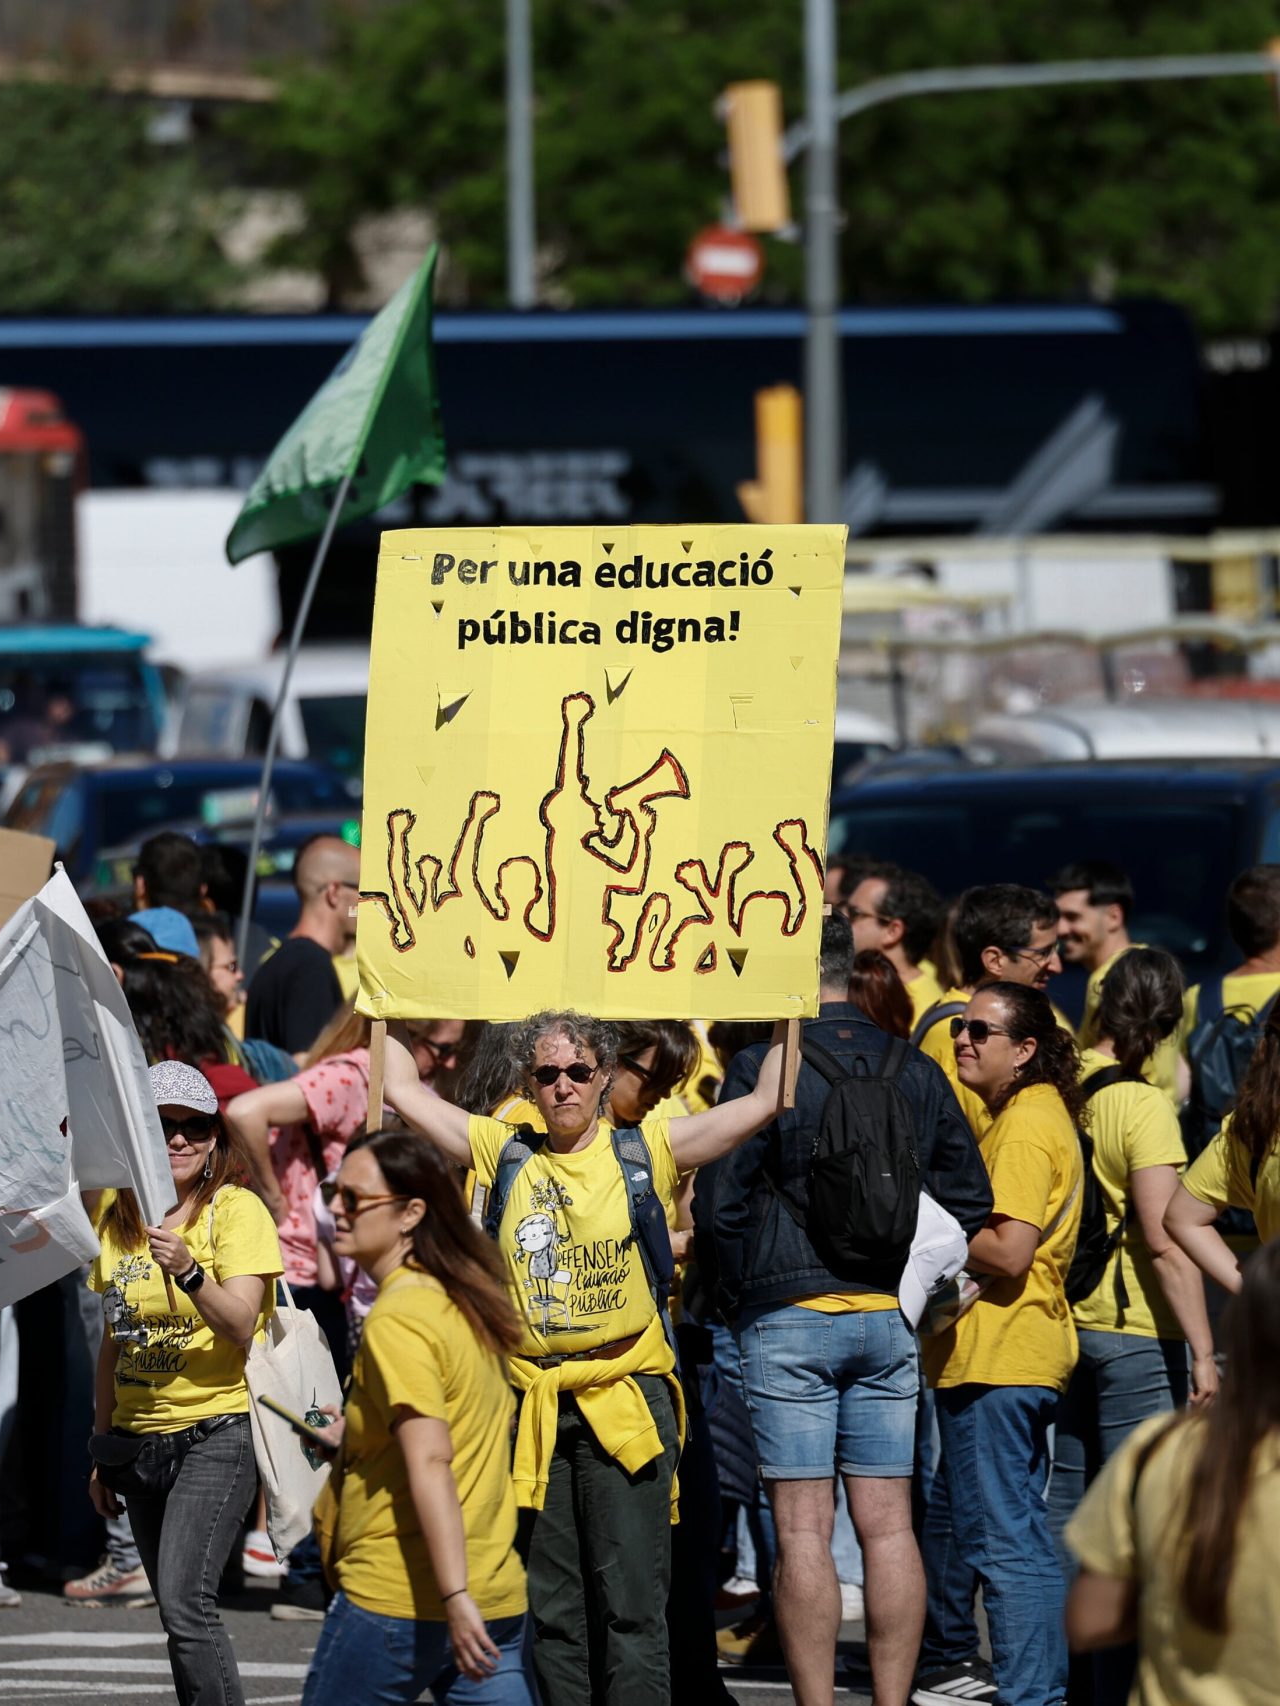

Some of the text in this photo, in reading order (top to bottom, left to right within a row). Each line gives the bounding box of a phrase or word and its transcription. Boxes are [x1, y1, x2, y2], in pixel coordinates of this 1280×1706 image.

[431, 548, 774, 589] Per una educació
[458, 609, 741, 653] pública digna!
[557, 1238, 626, 1271] DEFENSEM
